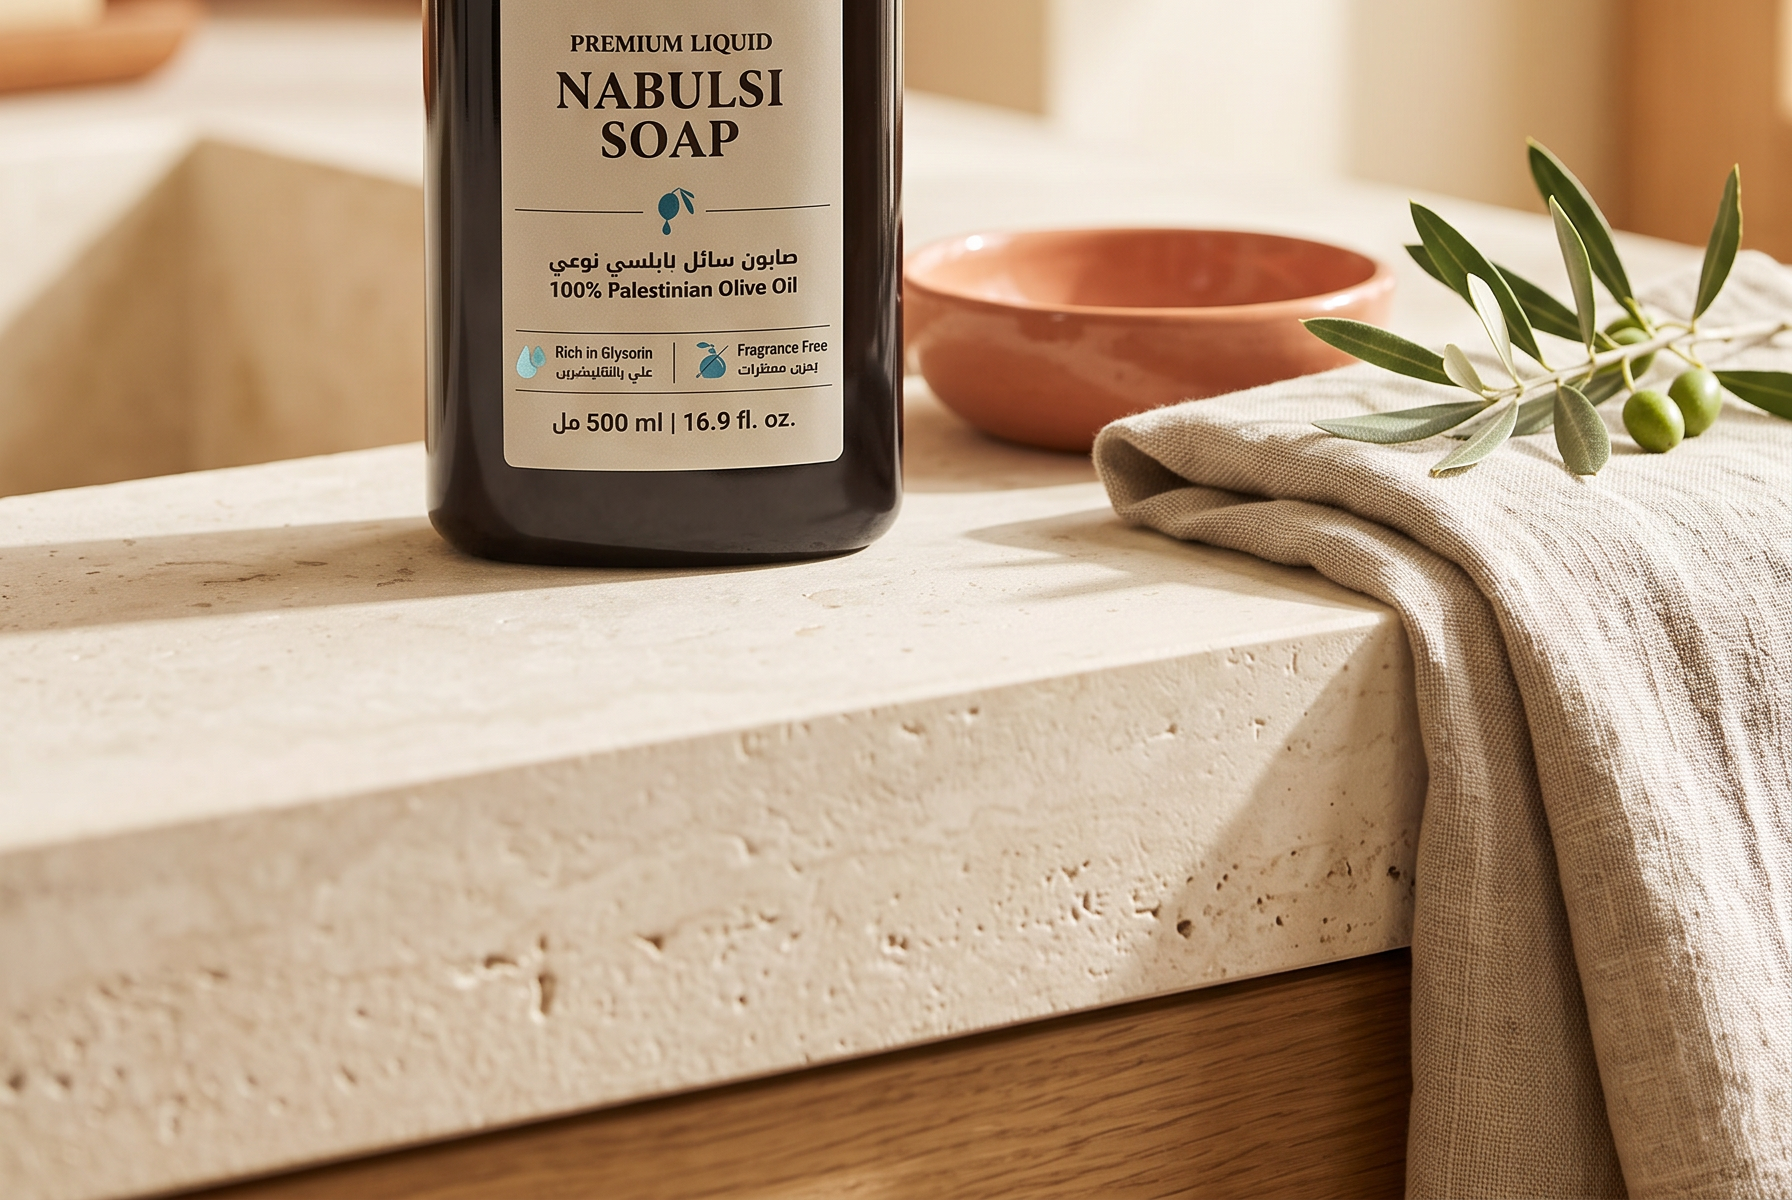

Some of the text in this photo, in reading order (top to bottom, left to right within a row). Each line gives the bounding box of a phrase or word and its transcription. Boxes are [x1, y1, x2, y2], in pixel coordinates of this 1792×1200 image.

[571, 33, 772, 55] PREMIUM LIQUID
[556, 69, 783, 109] NABULSI
[602, 120, 739, 158] SOAP
[550, 253, 598, 277] نوعي
[684, 250, 734, 273] سائل
[742, 249, 797, 271] صابون
[550, 277, 797, 298] 100% Palestinian Olive Oil
[556, 346, 652, 362] Rich in Glysorin
[738, 340, 827, 359] Fragrance Free
[553, 412, 580, 434] مل
[587, 413, 628, 432] 500
[636, 412, 662, 431] ml
[684, 412, 730, 431] 16.9
[736, 410, 757, 429] fl.
[765, 413, 795, 428] oz.
